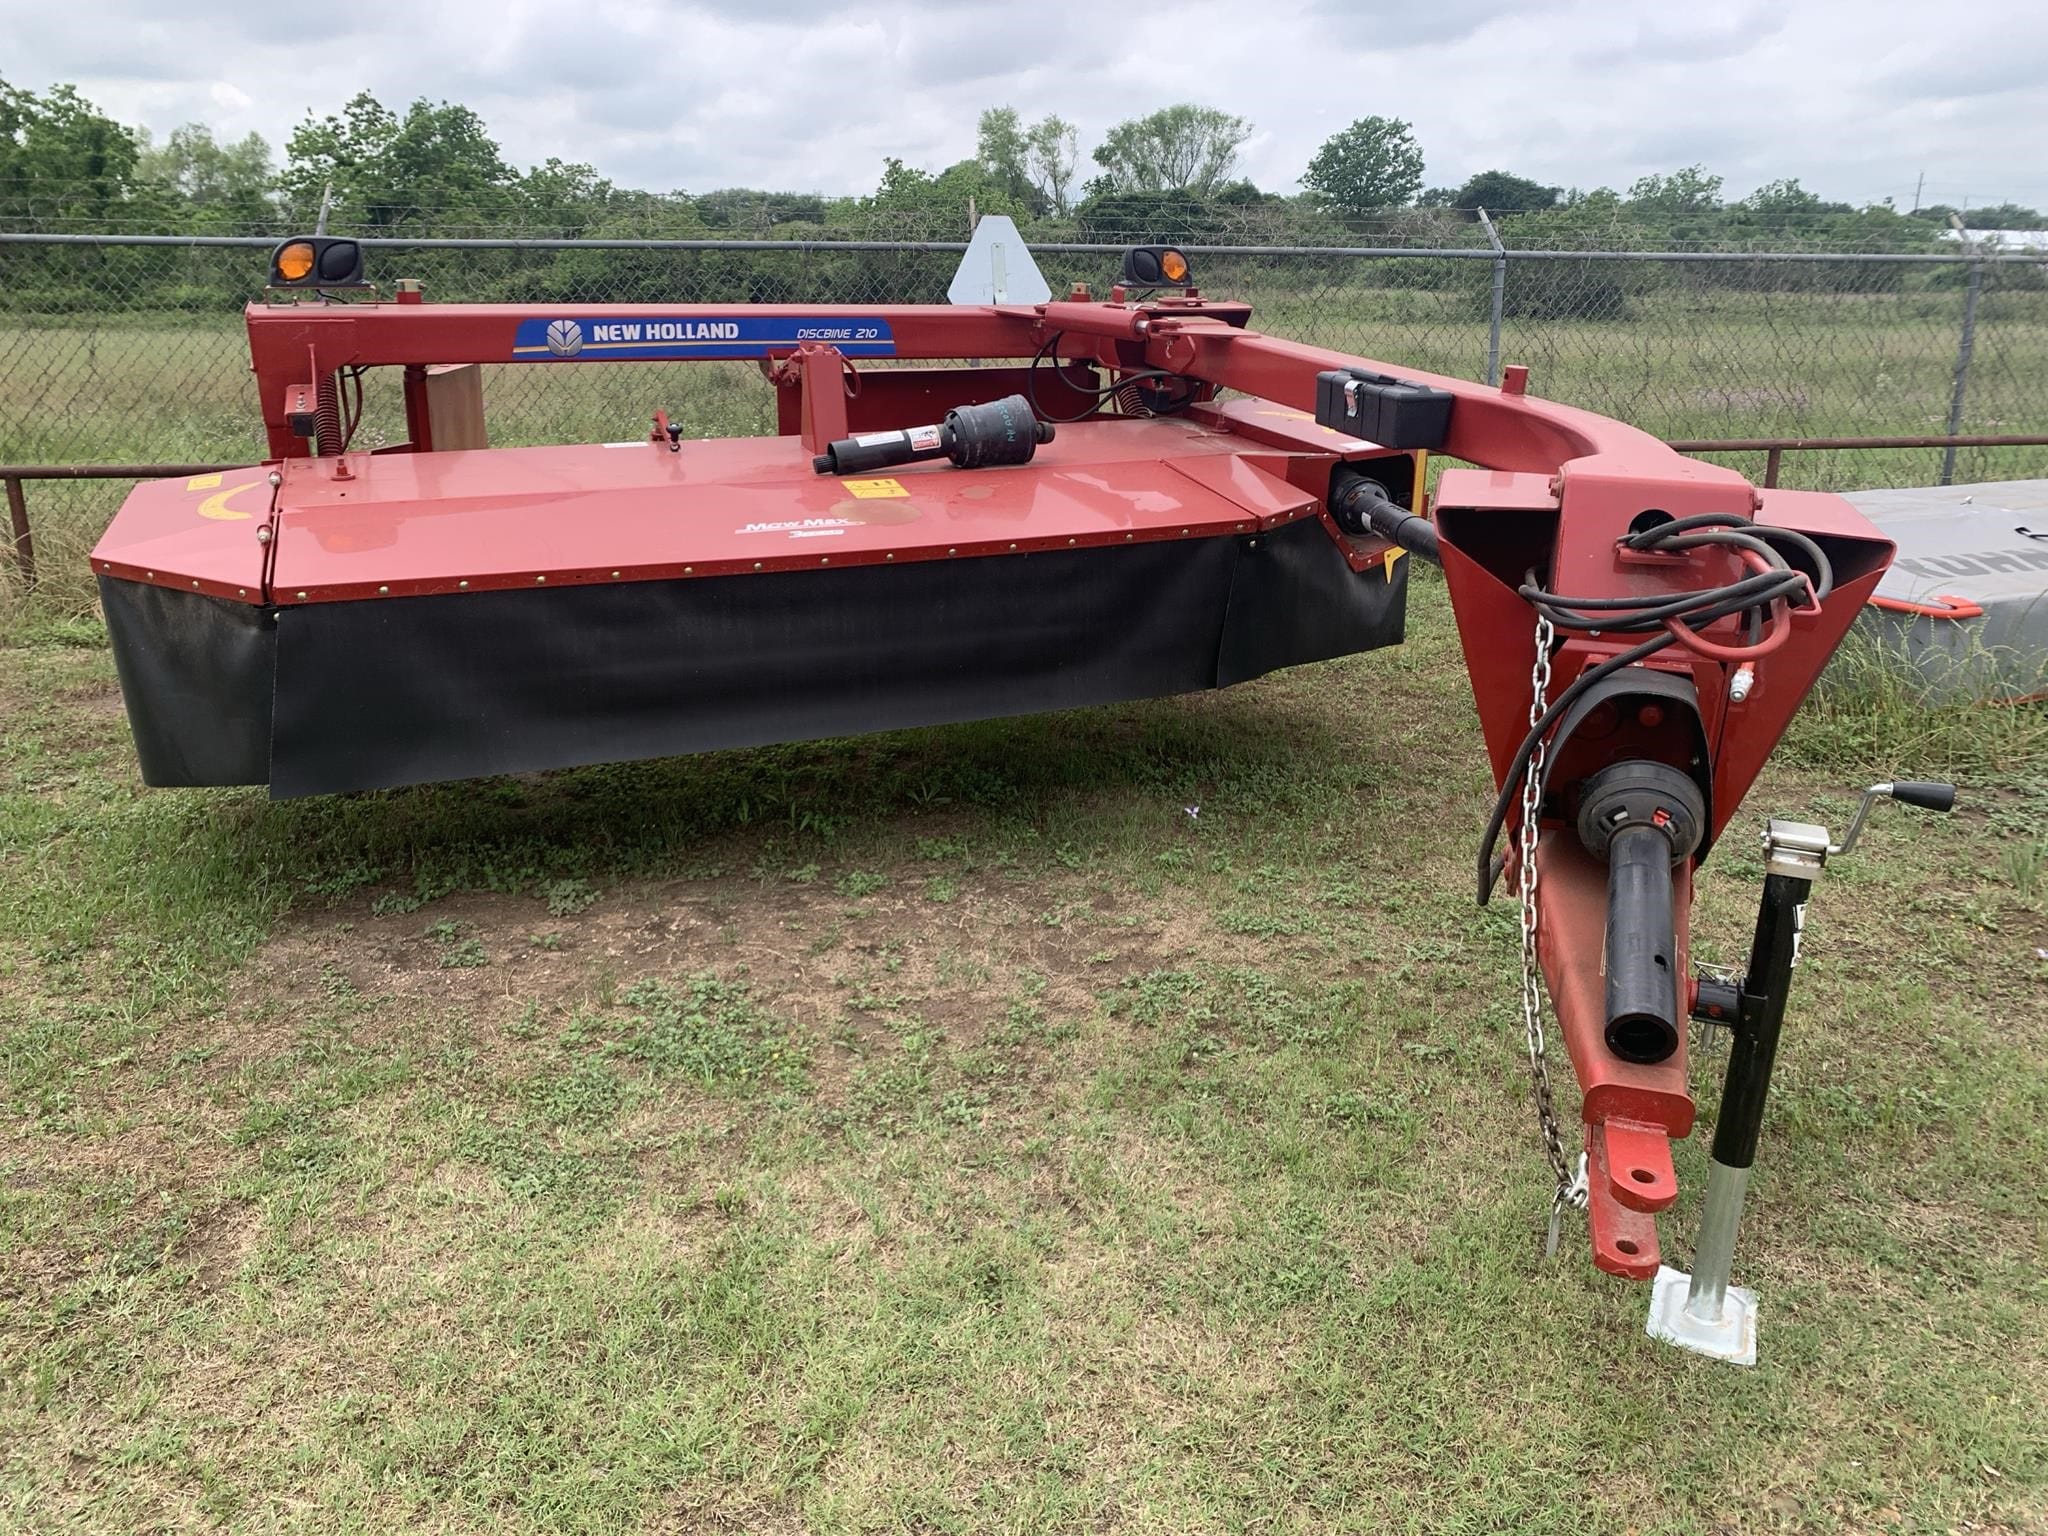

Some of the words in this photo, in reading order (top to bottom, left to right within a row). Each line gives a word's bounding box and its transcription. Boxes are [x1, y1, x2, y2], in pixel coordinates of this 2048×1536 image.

[593, 323, 641, 342] NEW
[646, 322, 739, 341] HOLLAND
[796, 328, 851, 339] DISCBINE
[856, 328, 878, 339] 210
